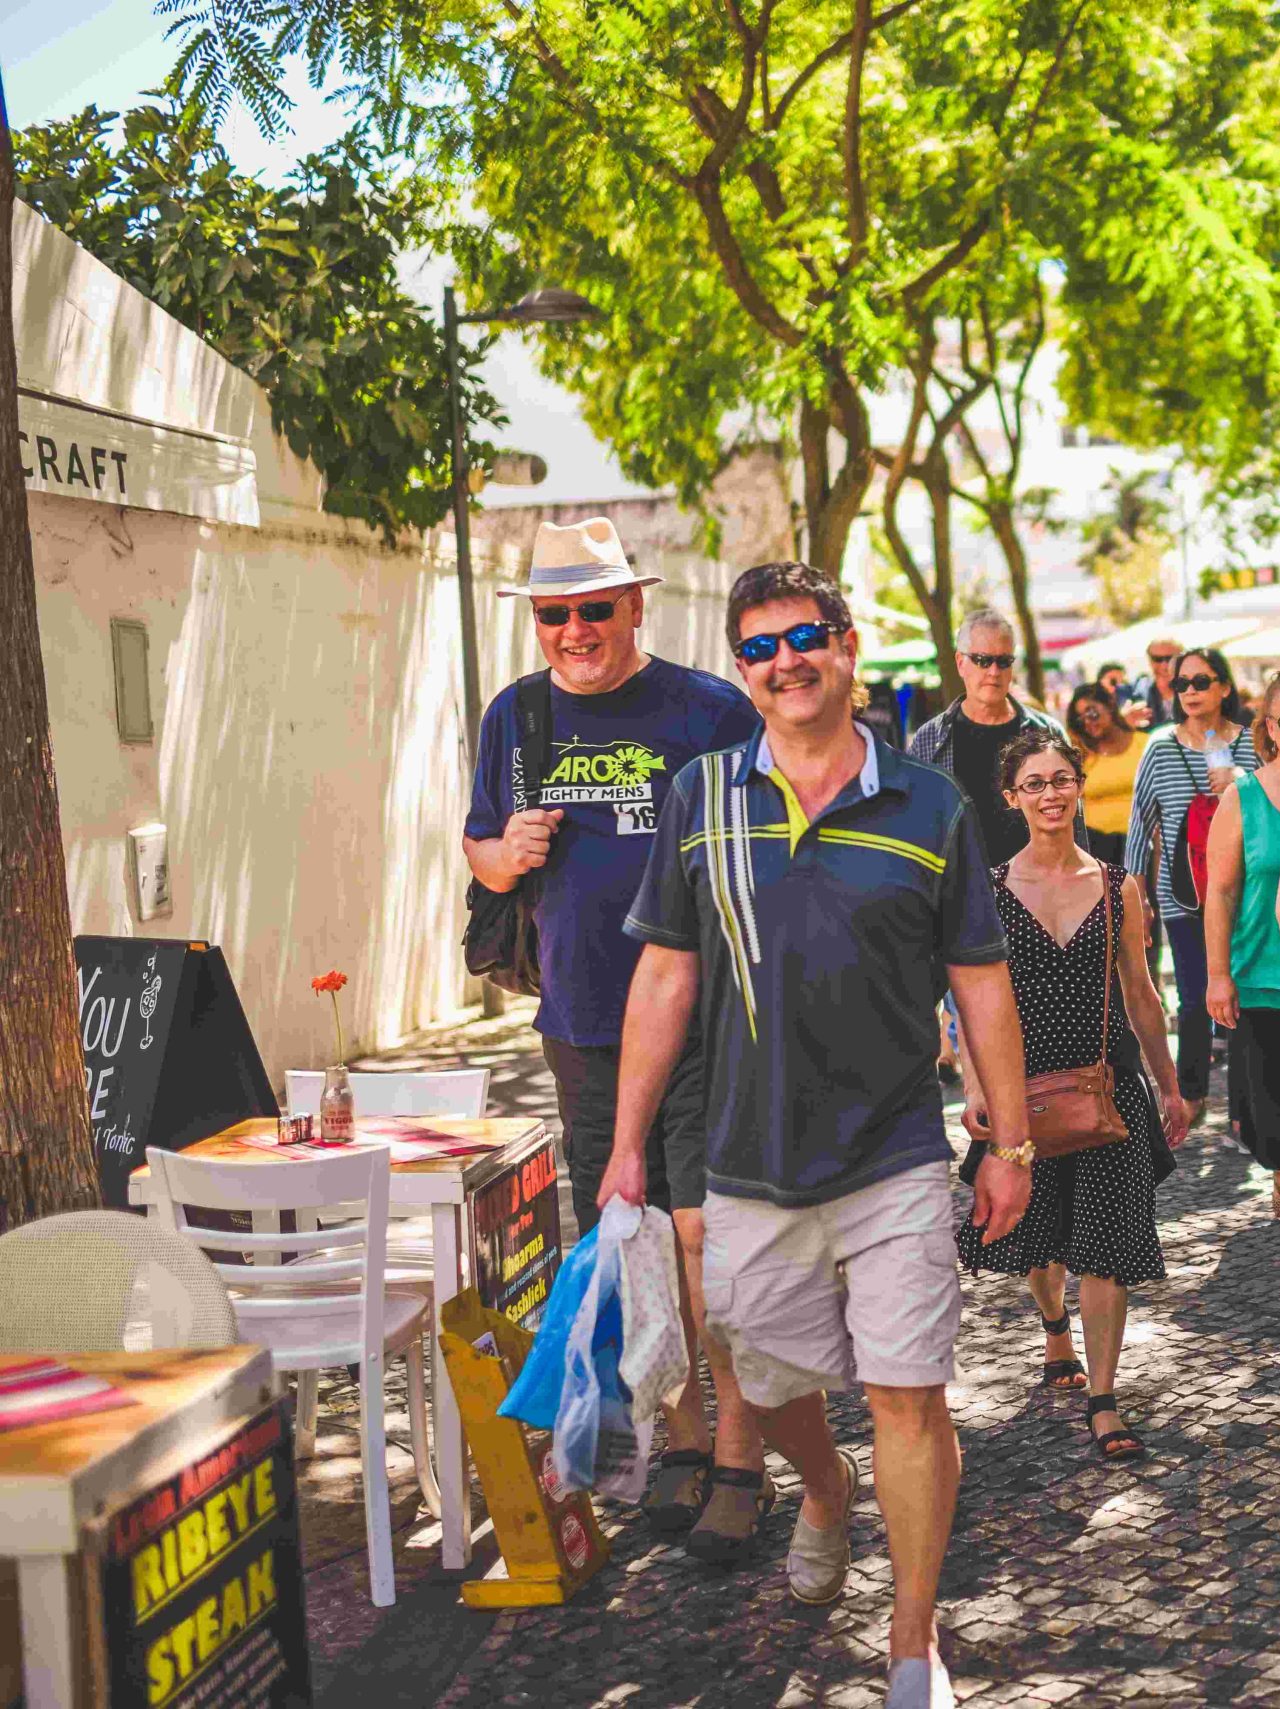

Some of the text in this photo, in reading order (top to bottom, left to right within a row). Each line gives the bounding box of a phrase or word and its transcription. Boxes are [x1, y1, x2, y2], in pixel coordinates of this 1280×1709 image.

[601, 786, 645, 799] MENS
[522, 1148, 558, 1202] GRILL
[503, 1233, 544, 1283] Shoarma
[506, 1277, 547, 1323] Sashlick
[132, 1456, 276, 1616] RIBEYE
[146, 1549, 276, 1705] STEAK
